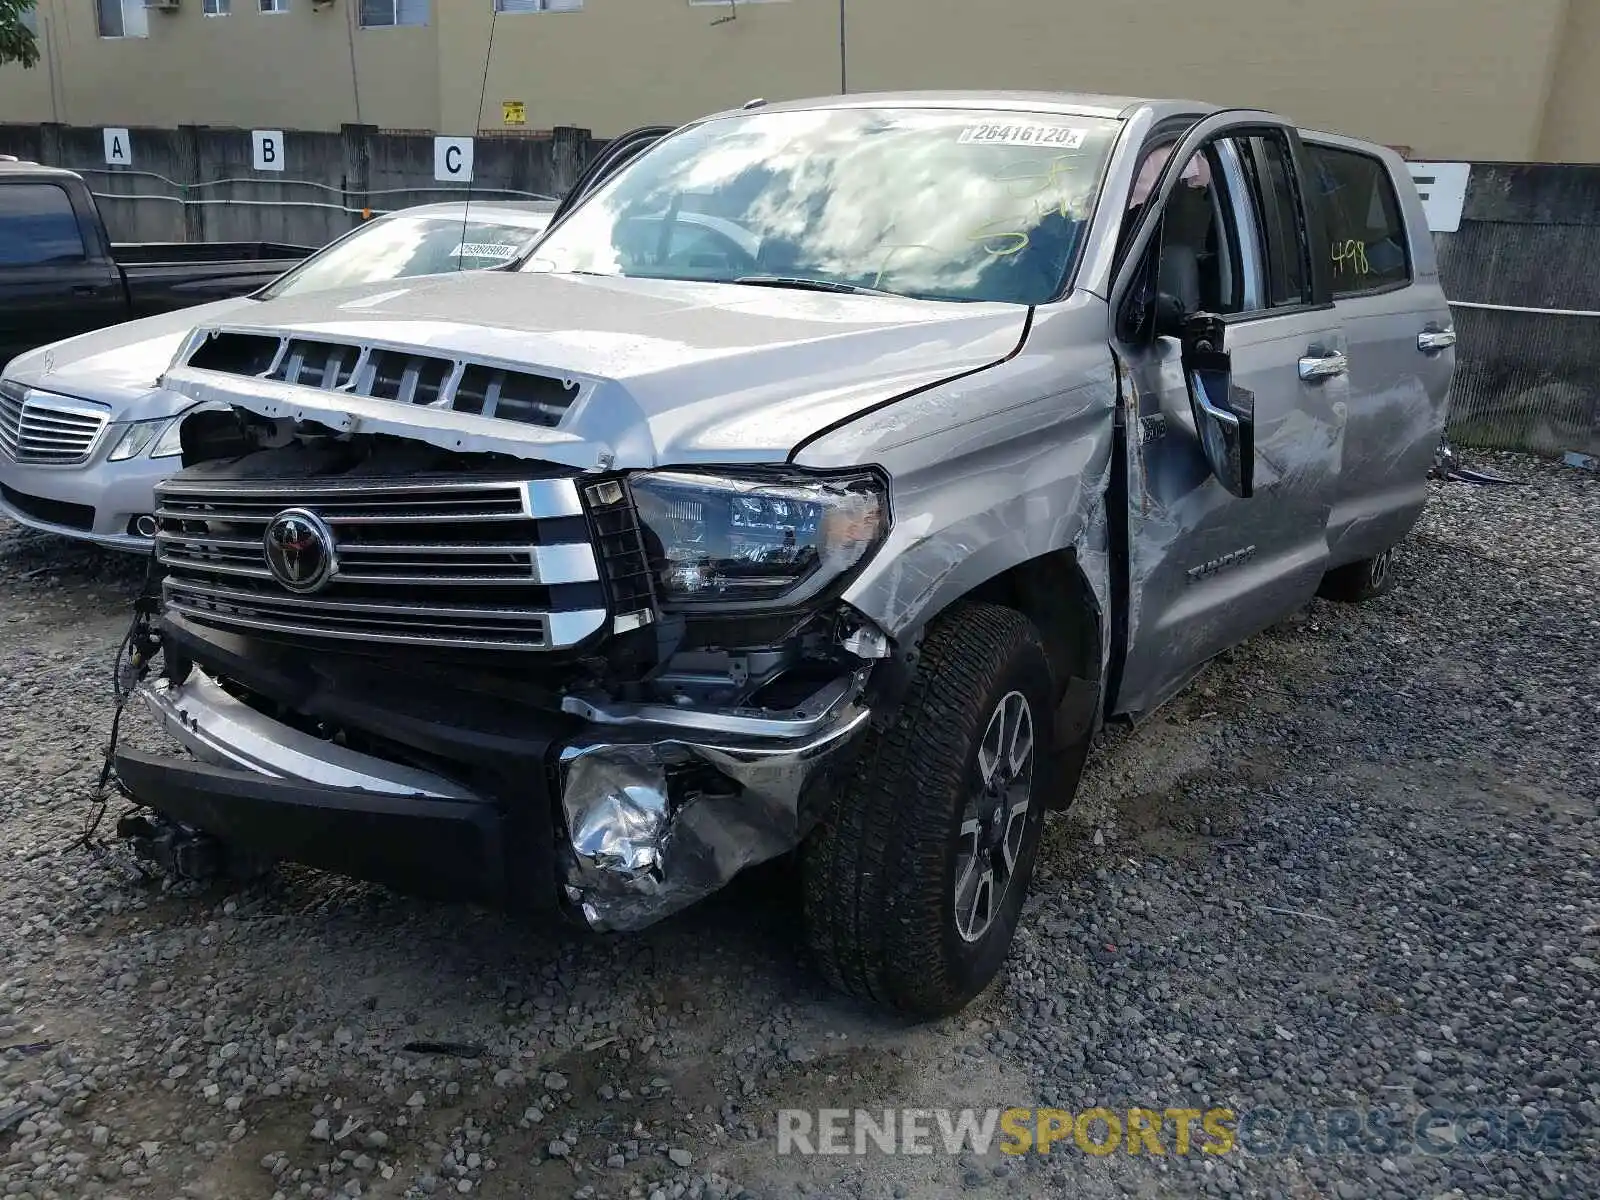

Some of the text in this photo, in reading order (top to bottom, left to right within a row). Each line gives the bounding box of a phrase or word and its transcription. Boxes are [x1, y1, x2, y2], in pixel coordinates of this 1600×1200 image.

[112, 136, 124, 159] A
[262, 138, 276, 163] B
[445, 145, 462, 174] C
[1331, 239, 1369, 275] 498
